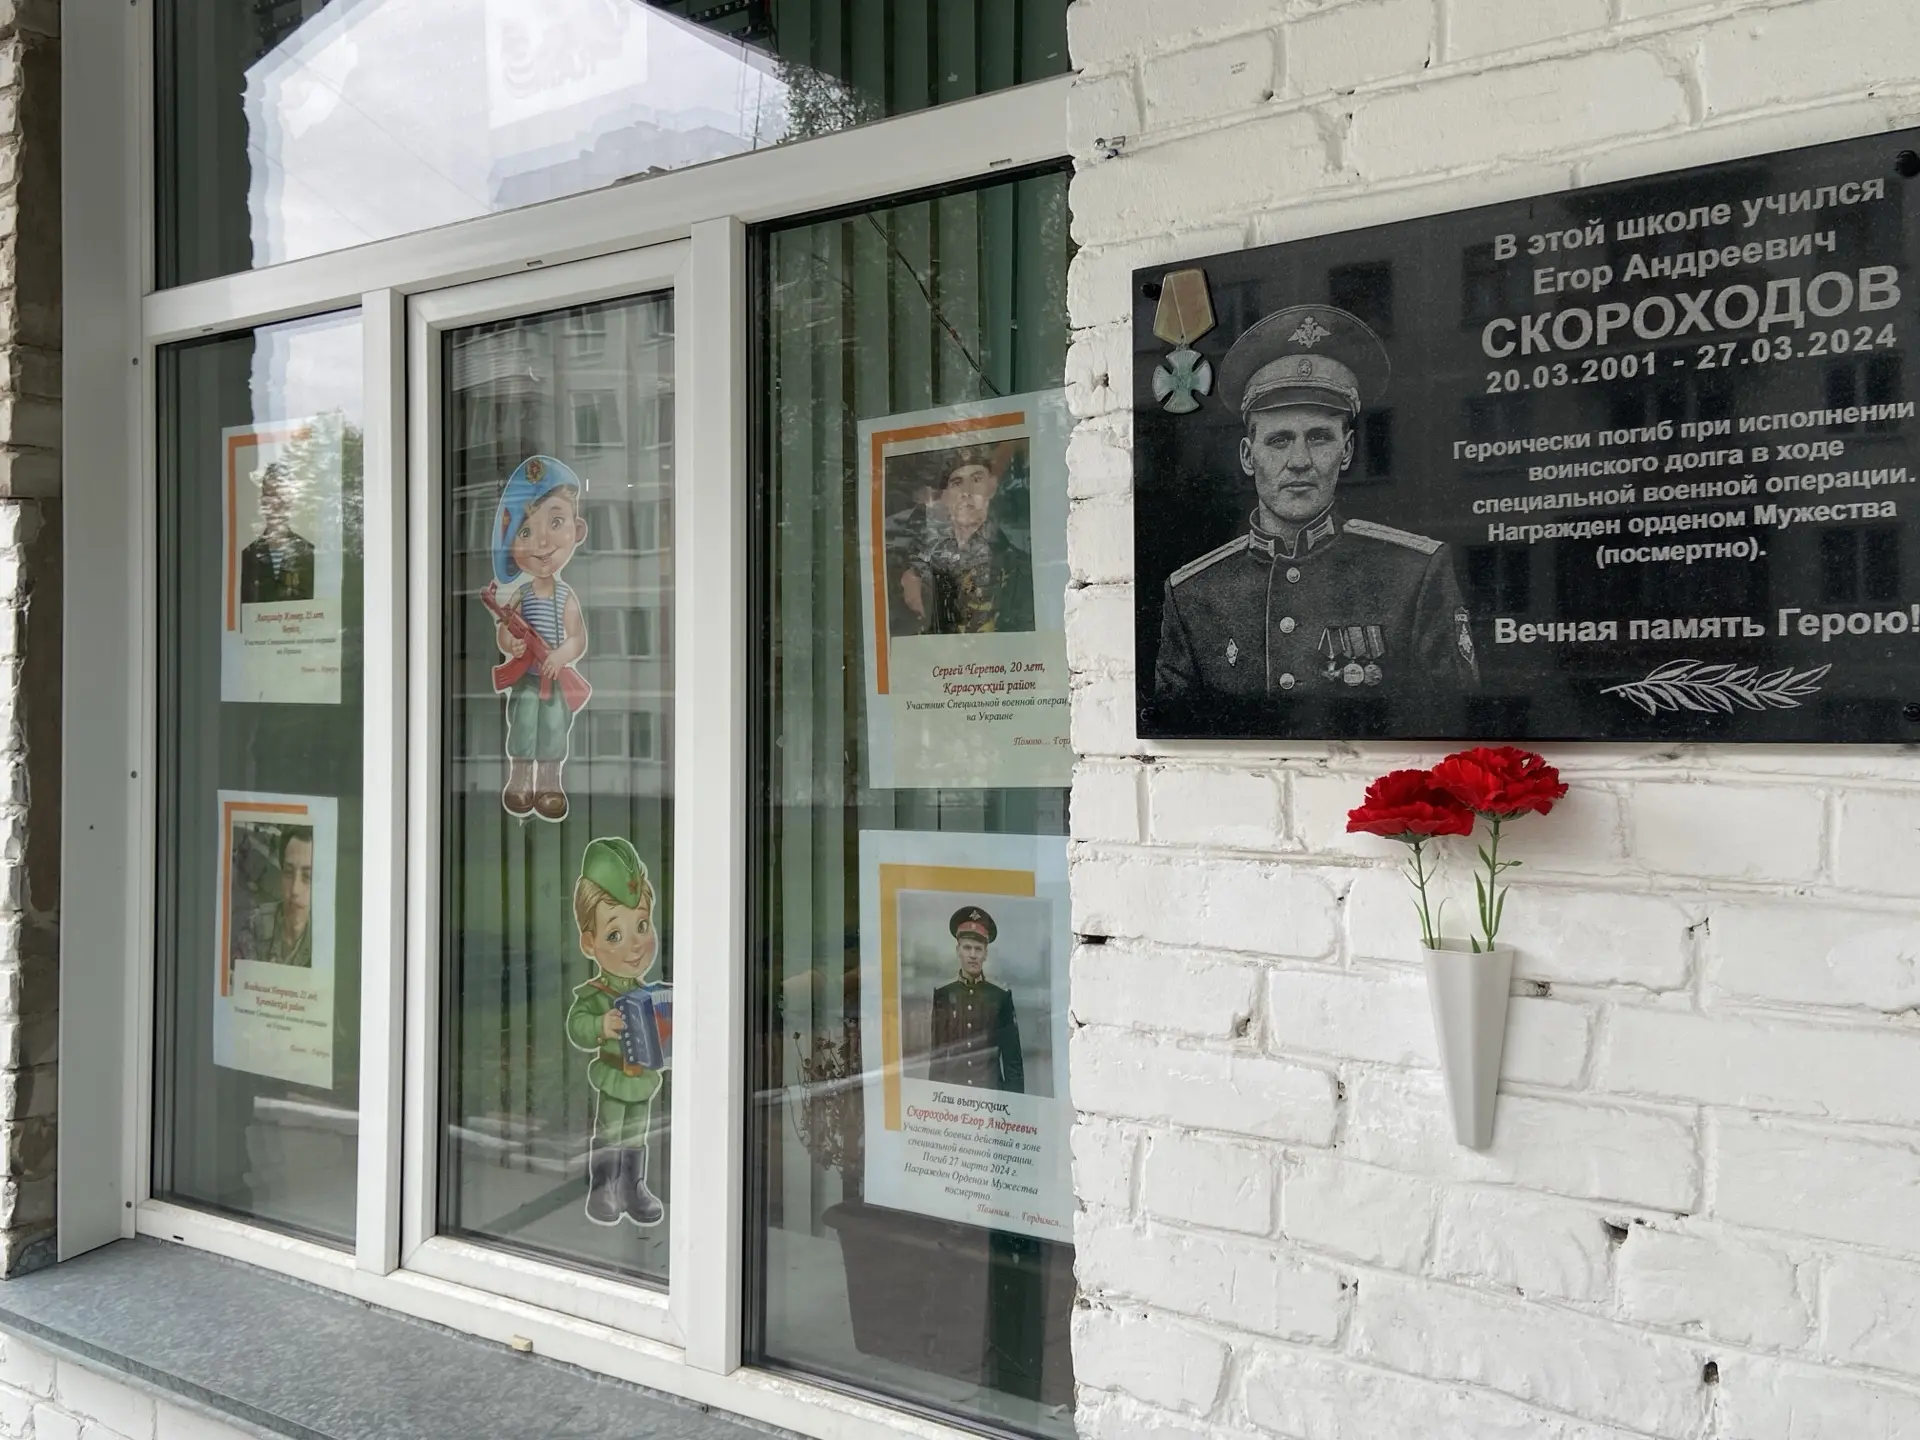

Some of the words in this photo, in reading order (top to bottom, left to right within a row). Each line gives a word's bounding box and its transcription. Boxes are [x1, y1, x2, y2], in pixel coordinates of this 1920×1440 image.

[1494, 234, 1517, 261] В
[1528, 220, 1605, 255] этой
[1617, 204, 1731, 241] школе
[1742, 178, 1885, 227] учился
[1534, 262, 1613, 295] Егор
[1623, 230, 1836, 282] Андреевич
[1482, 265, 1901, 358] СКОРОХОДОВ
[1487, 352, 1656, 394] 20.03.2001
[1697, 323, 1896, 369] 27.03.2024
[1453, 431, 1591, 460] Героически
[1599, 422, 1673, 453] погиб
[1681, 417, 1731, 449] при
[1739, 400, 1915, 438] исполнении
[1528, 454, 1659, 481] воинского
[1665, 446, 1744, 472] долга
[1752, 446, 1768, 462] в
[1775, 440, 1844, 465] ходе
[1472, 484, 1636, 517] специальной
[1643, 474, 1758, 502] военной
[1765, 467, 1915, 497] операции.
[1488, 519, 1621, 544] Награжден
[1628, 509, 1746, 538] орденом
[1753, 498, 1896, 533] Мужества
[1596, 535, 1766, 569] (посмертно).
[1494, 617, 1619, 644] Вечная
[1629, 614, 1766, 641] память
[1778, 605, 1920, 644] Герою!
[933, 665, 963, 679] Сергей
[1010, 662, 1022, 673] 20
[1024, 662, 1045, 672] лет,
[906, 701, 945, 710] Участник
[947, 698, 999, 710] Специальной
[1001, 697, 1035, 706] военной
[1037, 696, 1068, 707] операц
[943, 681, 1004, 696] Карасукский
[1007, 680, 1036, 694] район
[978, 712, 1013, 723] Украине
[933, 1091, 955, 1105] Наш
[957, 1097, 1011, 1115] выпускник
[907, 1105, 959, 1123] Скороходов
[960, 1113, 984, 1129] Егор
[987, 1118, 1038, 1135] Андреевич
[903, 1122, 942, 1137] Участник
[944, 1128, 972, 1141] боевых
[974, 1133, 1014, 1148] действий
[1015, 1141, 1021, 1149] в
[1022, 1142, 1042, 1153] зоне
[908, 1138, 957, 1153] специальной
[959, 1144, 992, 1158] военной
[904, 1162, 951, 1179] Награжден
[952, 1169, 989, 1186] Орденом
[991, 1178, 1038, 1195] Мужества
[923, 1152, 947, 1165] Погиб
[948, 1156, 959, 1166] 27
[960, 1160, 988, 1173] марта
[990, 1165, 1010, 1176] 2024
